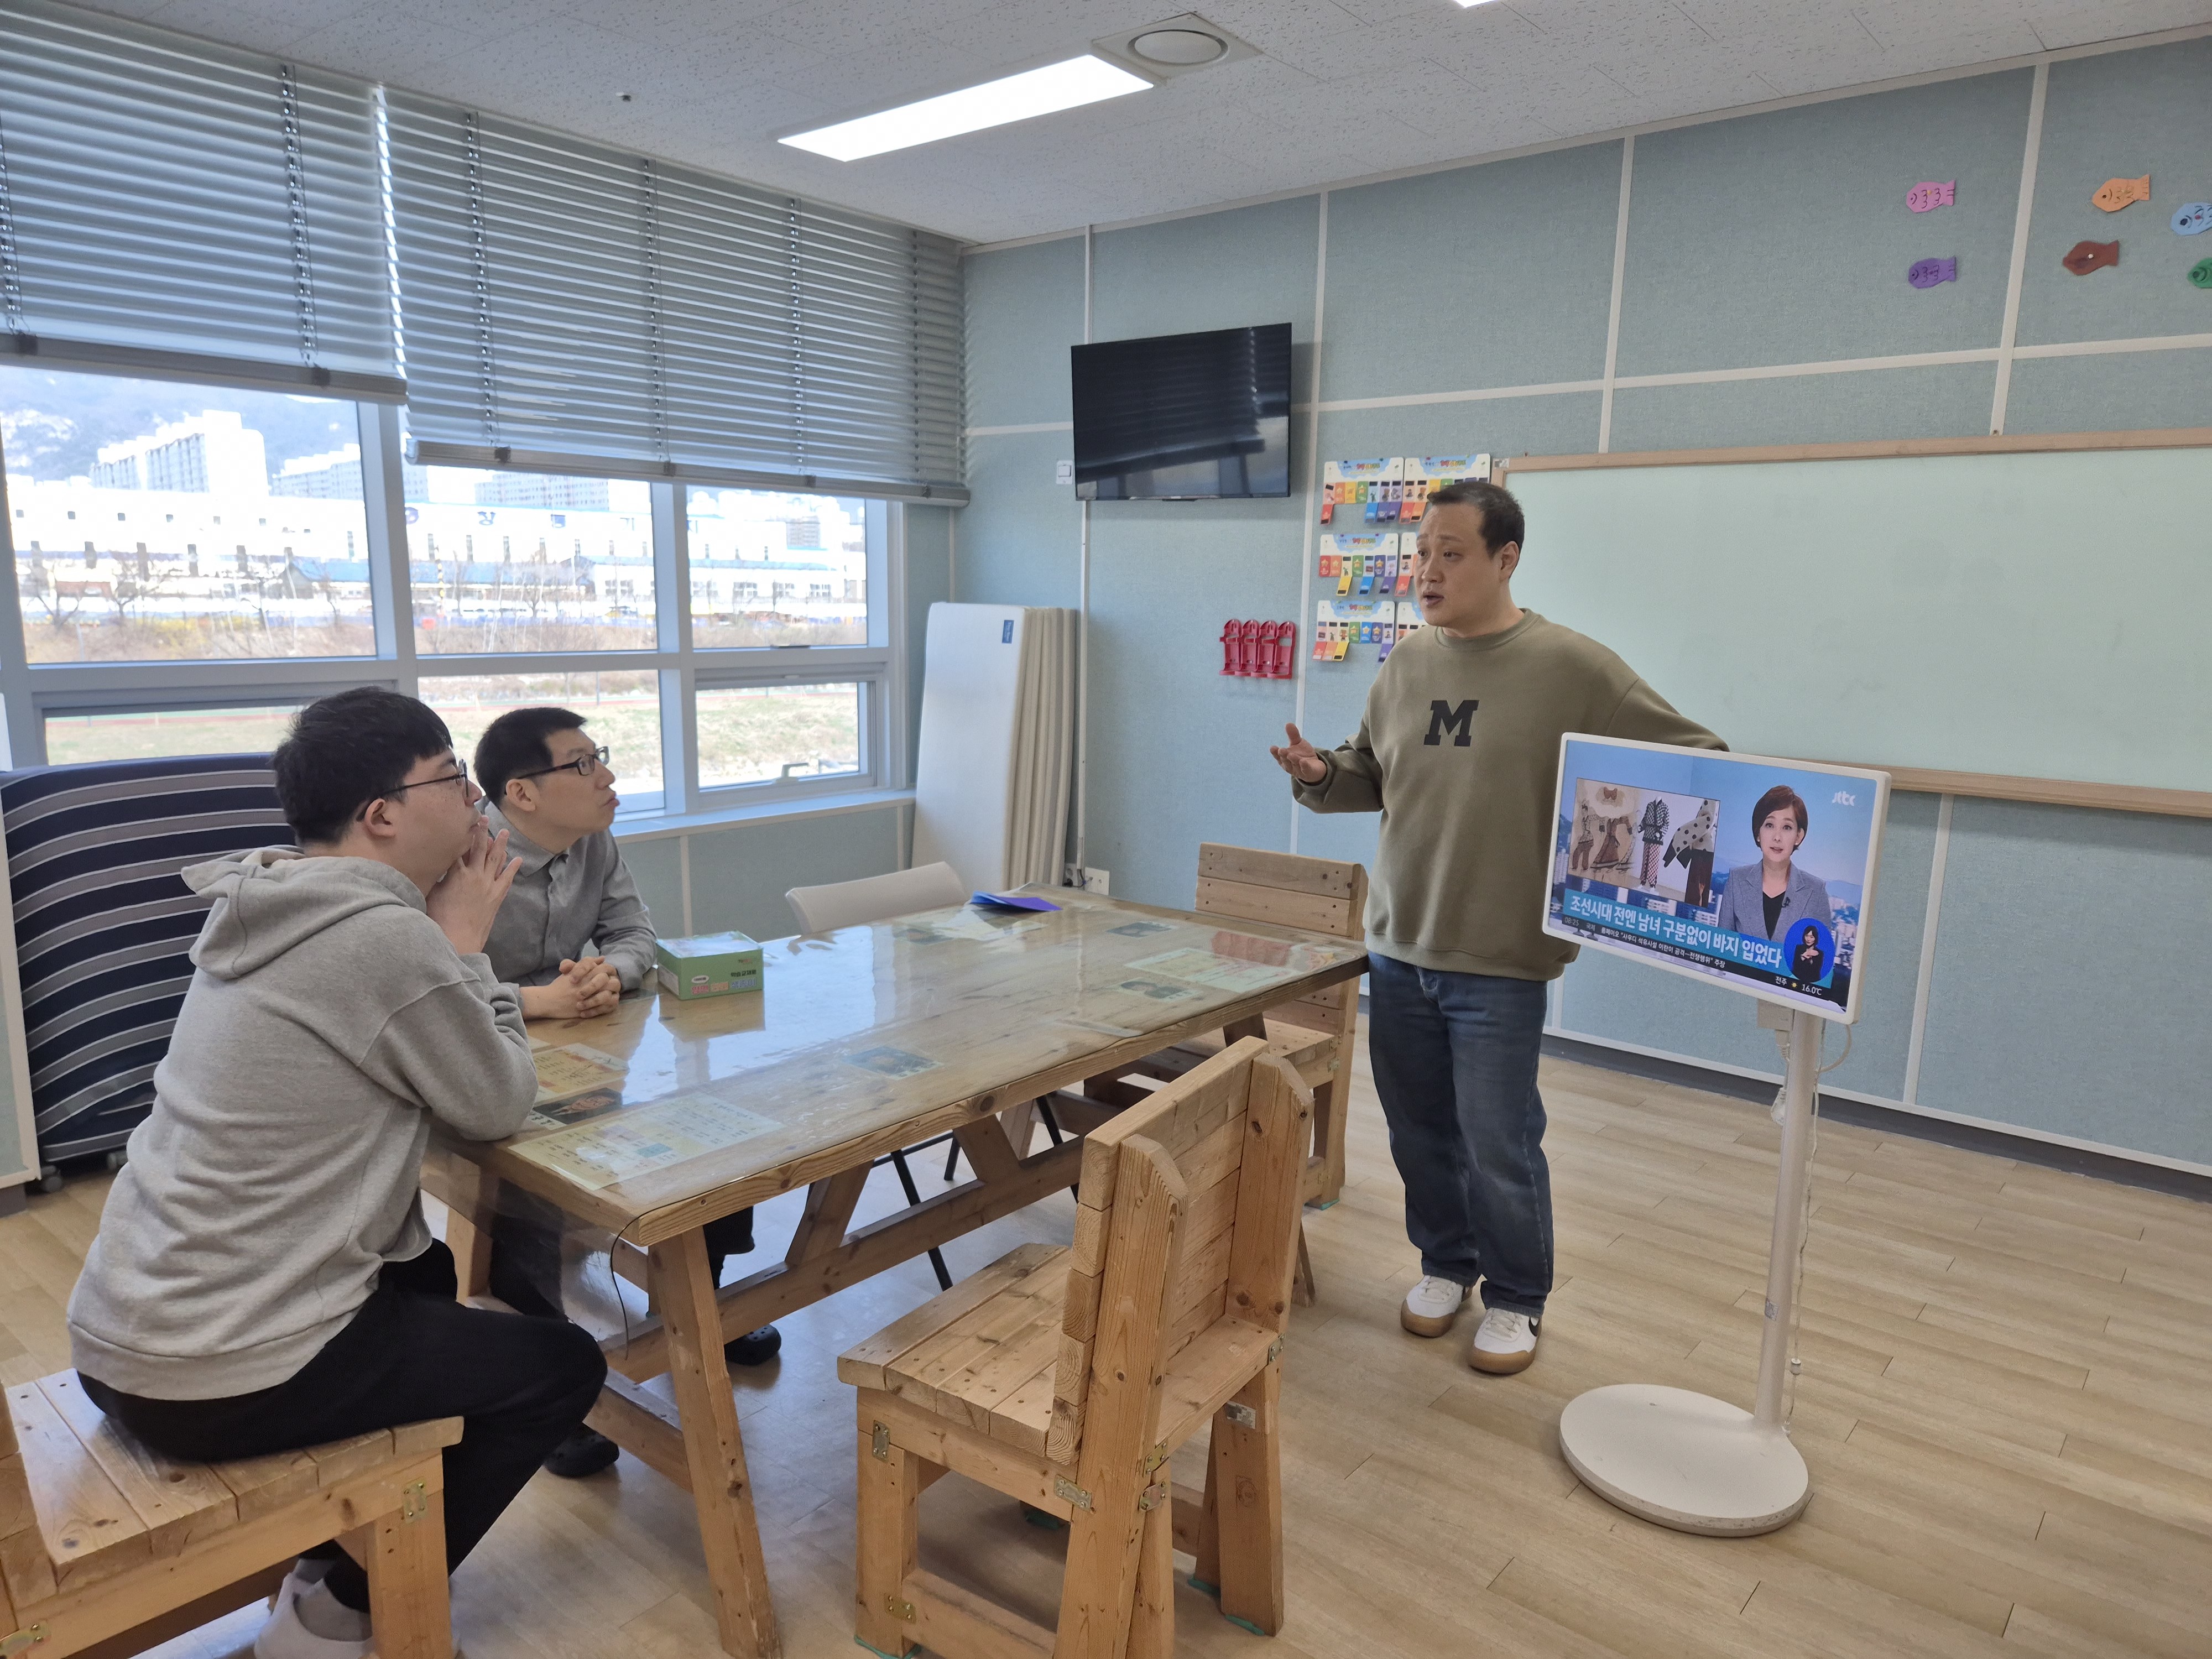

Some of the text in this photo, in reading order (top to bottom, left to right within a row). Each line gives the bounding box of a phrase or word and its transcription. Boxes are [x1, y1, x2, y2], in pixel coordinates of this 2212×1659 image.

[1423, 699, 1480, 747] M
[1564, 917, 1579, 927] 08:25
[1571, 896, 1782, 968] 조선시대 전엔 남녀 구분없이 바지 입었다
[1638, 937, 1657, 948] 석유시설
[1659, 943, 1673, 953] 이란이
[1714, 959, 1726, 968] 주장
[1775, 976, 1787, 986] 전주
